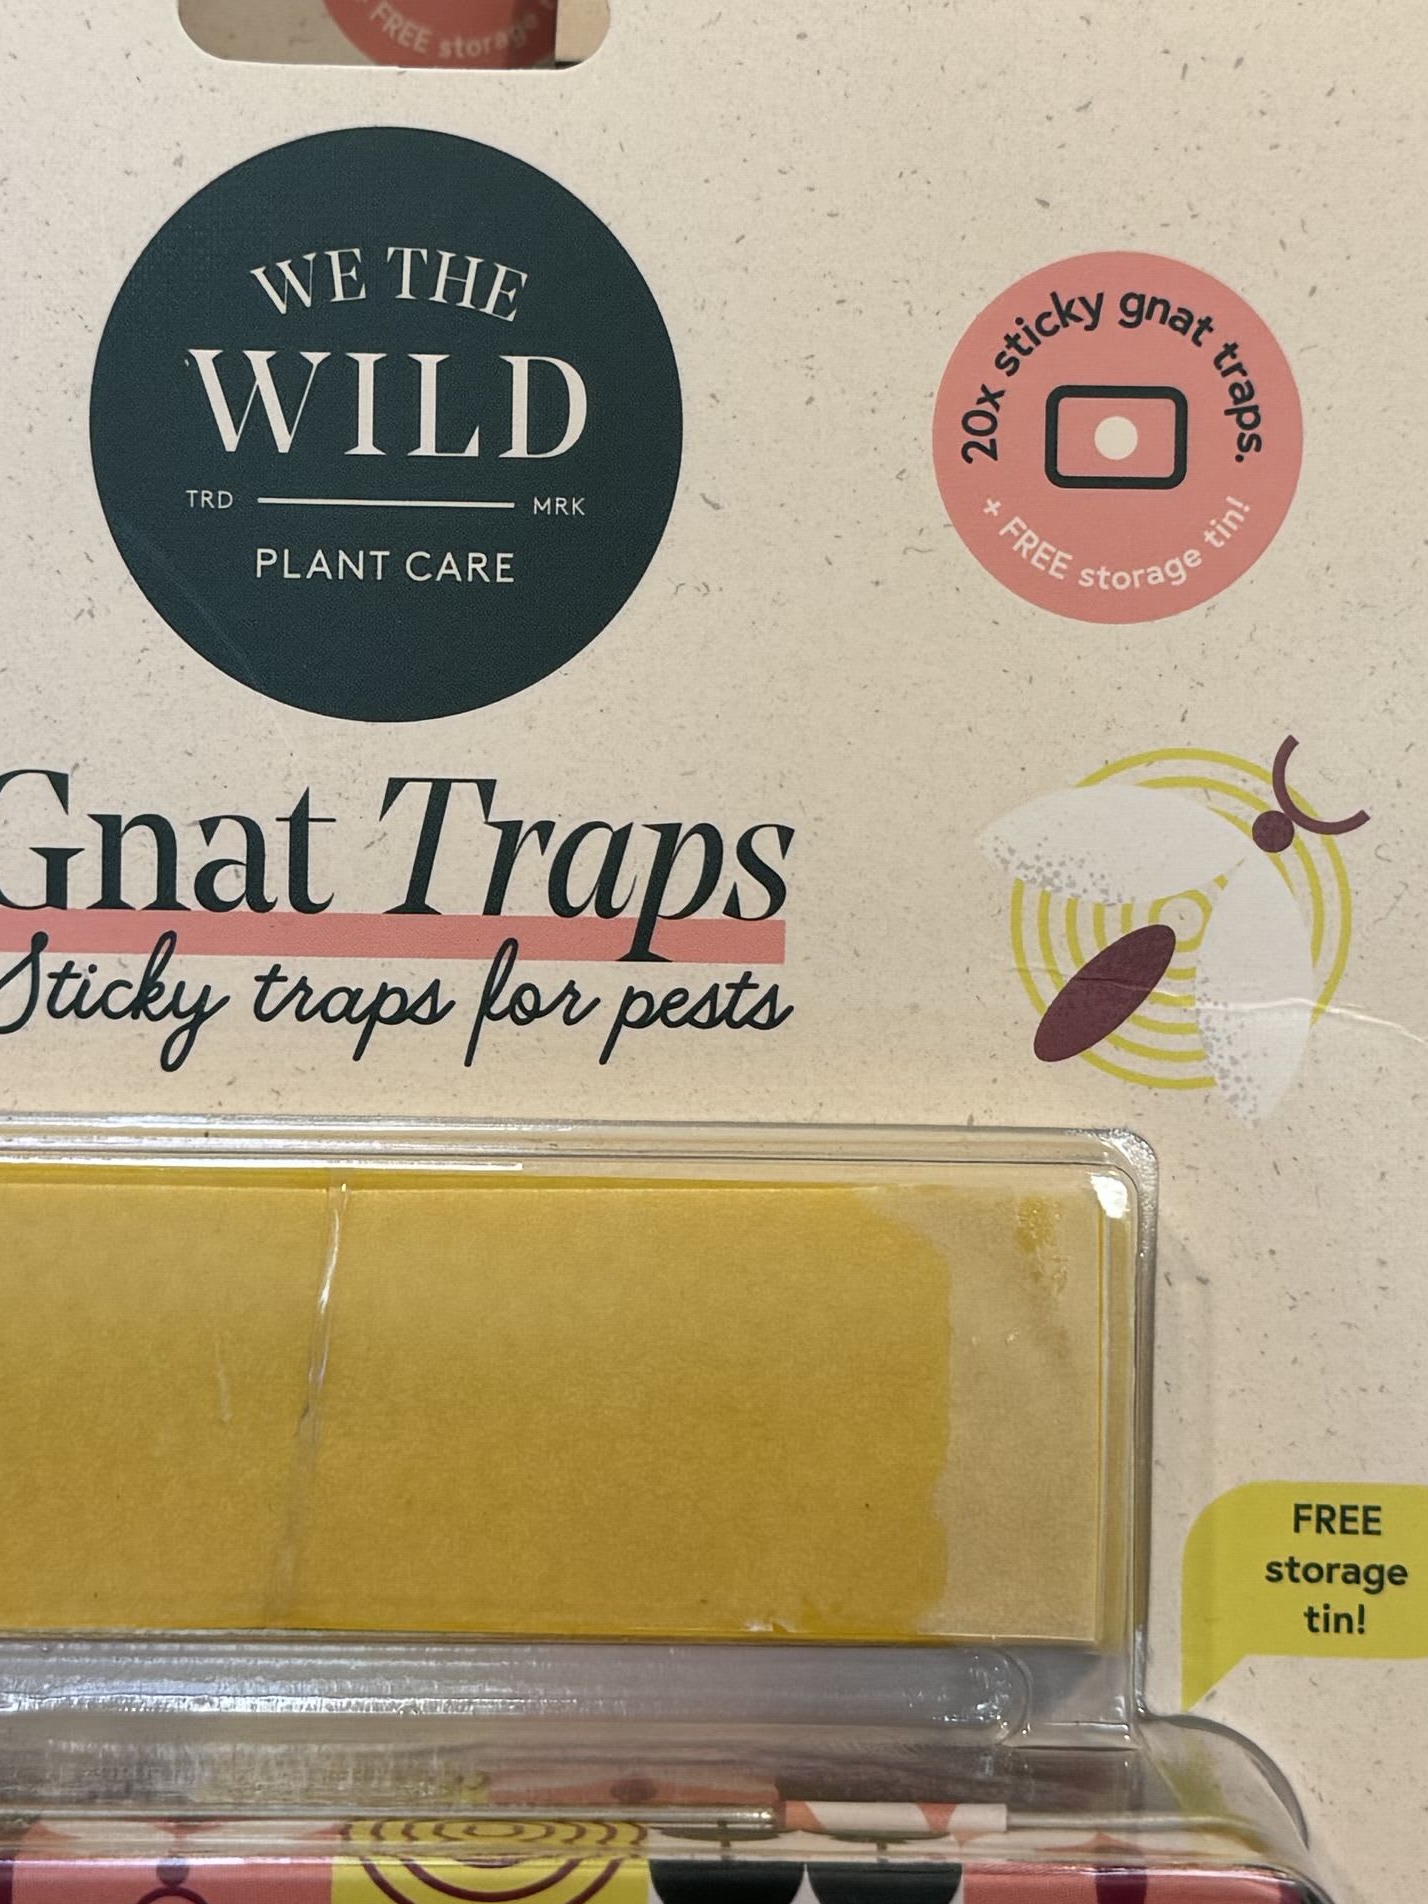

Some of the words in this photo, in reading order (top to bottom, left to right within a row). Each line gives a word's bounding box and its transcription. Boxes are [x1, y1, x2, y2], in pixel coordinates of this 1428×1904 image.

[369, 0, 435, 55] FREE
[438, 13, 538, 59] storage
[249, 246, 368, 318] WE
[384, 245, 529, 323] THE
[185, 346, 587, 460] WILD
[961, 384, 1006, 464] 20x
[994, 291, 1105, 377] sticky
[1118, 291, 1216, 347] gnat
[1213, 341, 1263, 463] traps.
[185, 488, 234, 510] TRD
[532, 495, 586, 517] MRK
[255, 547, 392, 582] PLANT
[404, 549, 515, 585] CARE
[999, 515, 1073, 580] FREE
[1078, 549, 1203, 591] storage
[1203, 495, 1251, 550] tin!
[378, 776, 796, 963] Traps
[254, 962, 455, 1062] traps
[463, 938, 601, 1067] for
[598, 970, 796, 1065] pests
[1293, 1503, 1382, 1535] FREE
[1265, 1556, 1408, 1595] storage
[1303, 1603, 1365, 1634] tin!
